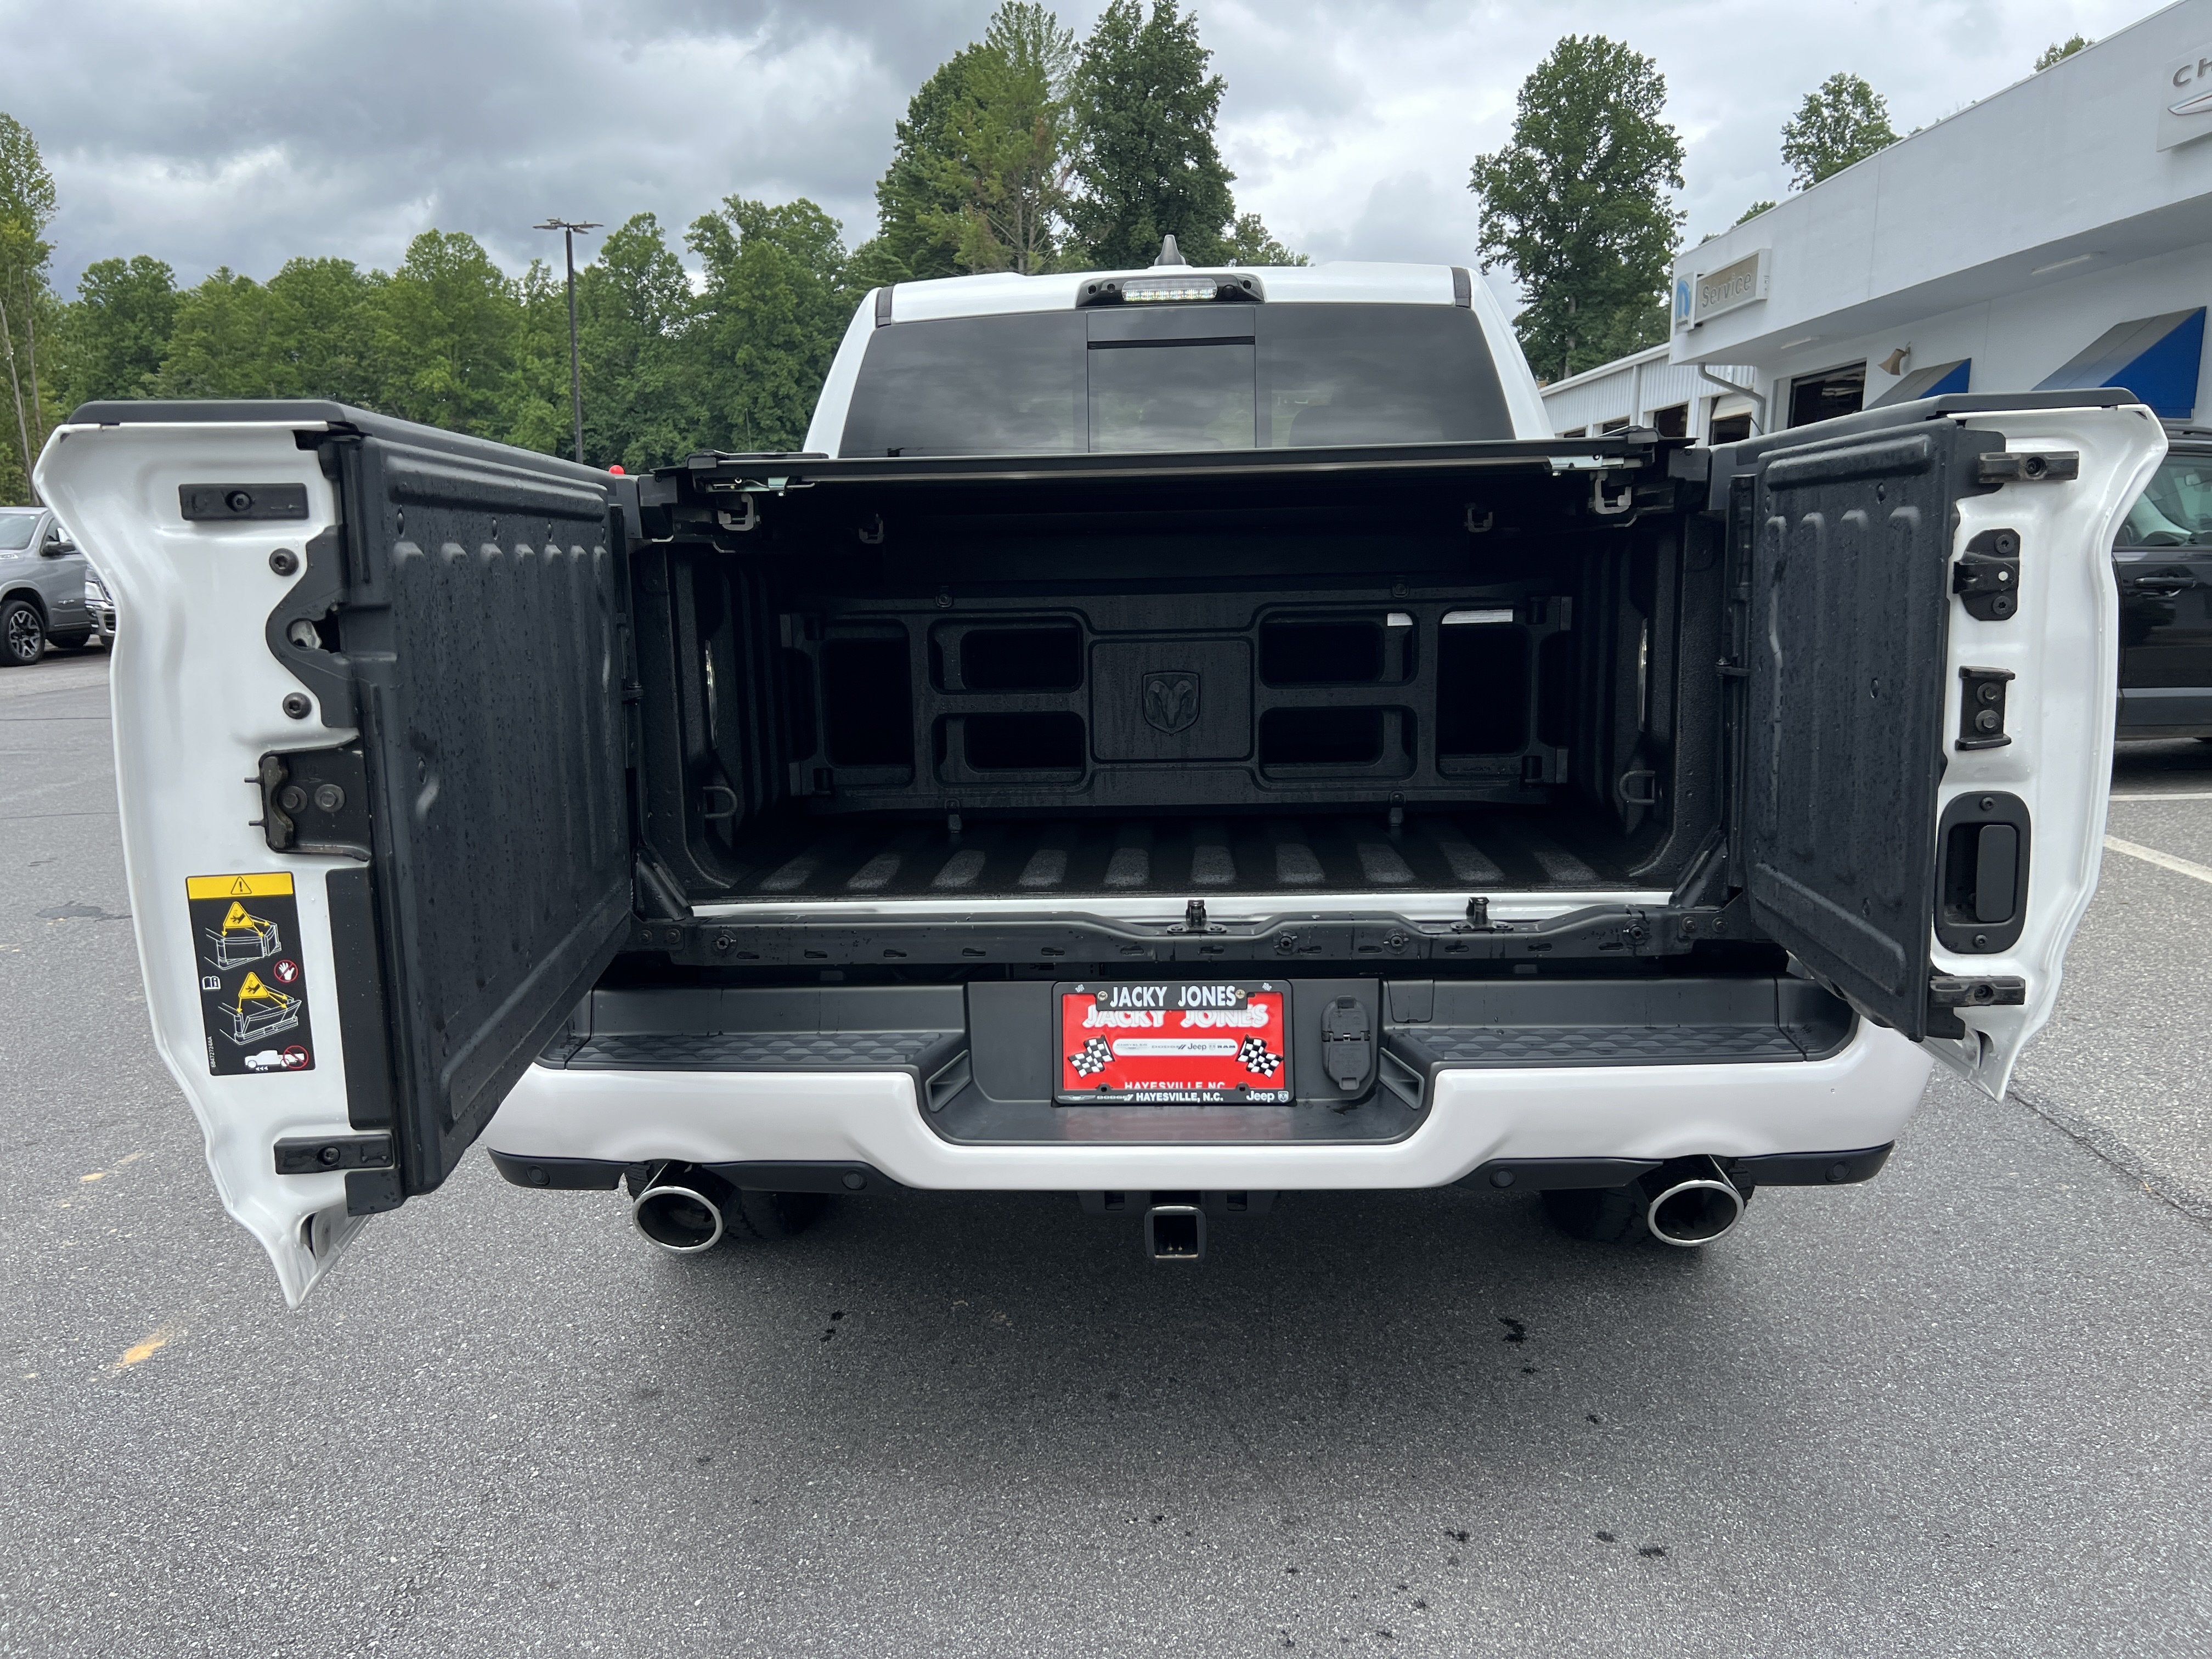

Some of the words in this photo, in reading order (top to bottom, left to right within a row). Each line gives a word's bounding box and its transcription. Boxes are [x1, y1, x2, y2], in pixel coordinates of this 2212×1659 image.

[1702, 272, 1751, 308] Service
[1110, 986, 1167, 1007] JACKY
[1178, 986, 1236, 1007] JONES
[1082, 1005, 1166, 1028] JACKY
[1180, 1004, 1269, 1028] JONES
[1136, 1092, 1200, 1102] HAYESVILLE,
[1203, 1092, 1223, 1101] N.C.
[1246, 1091, 1275, 1103] Jeep
